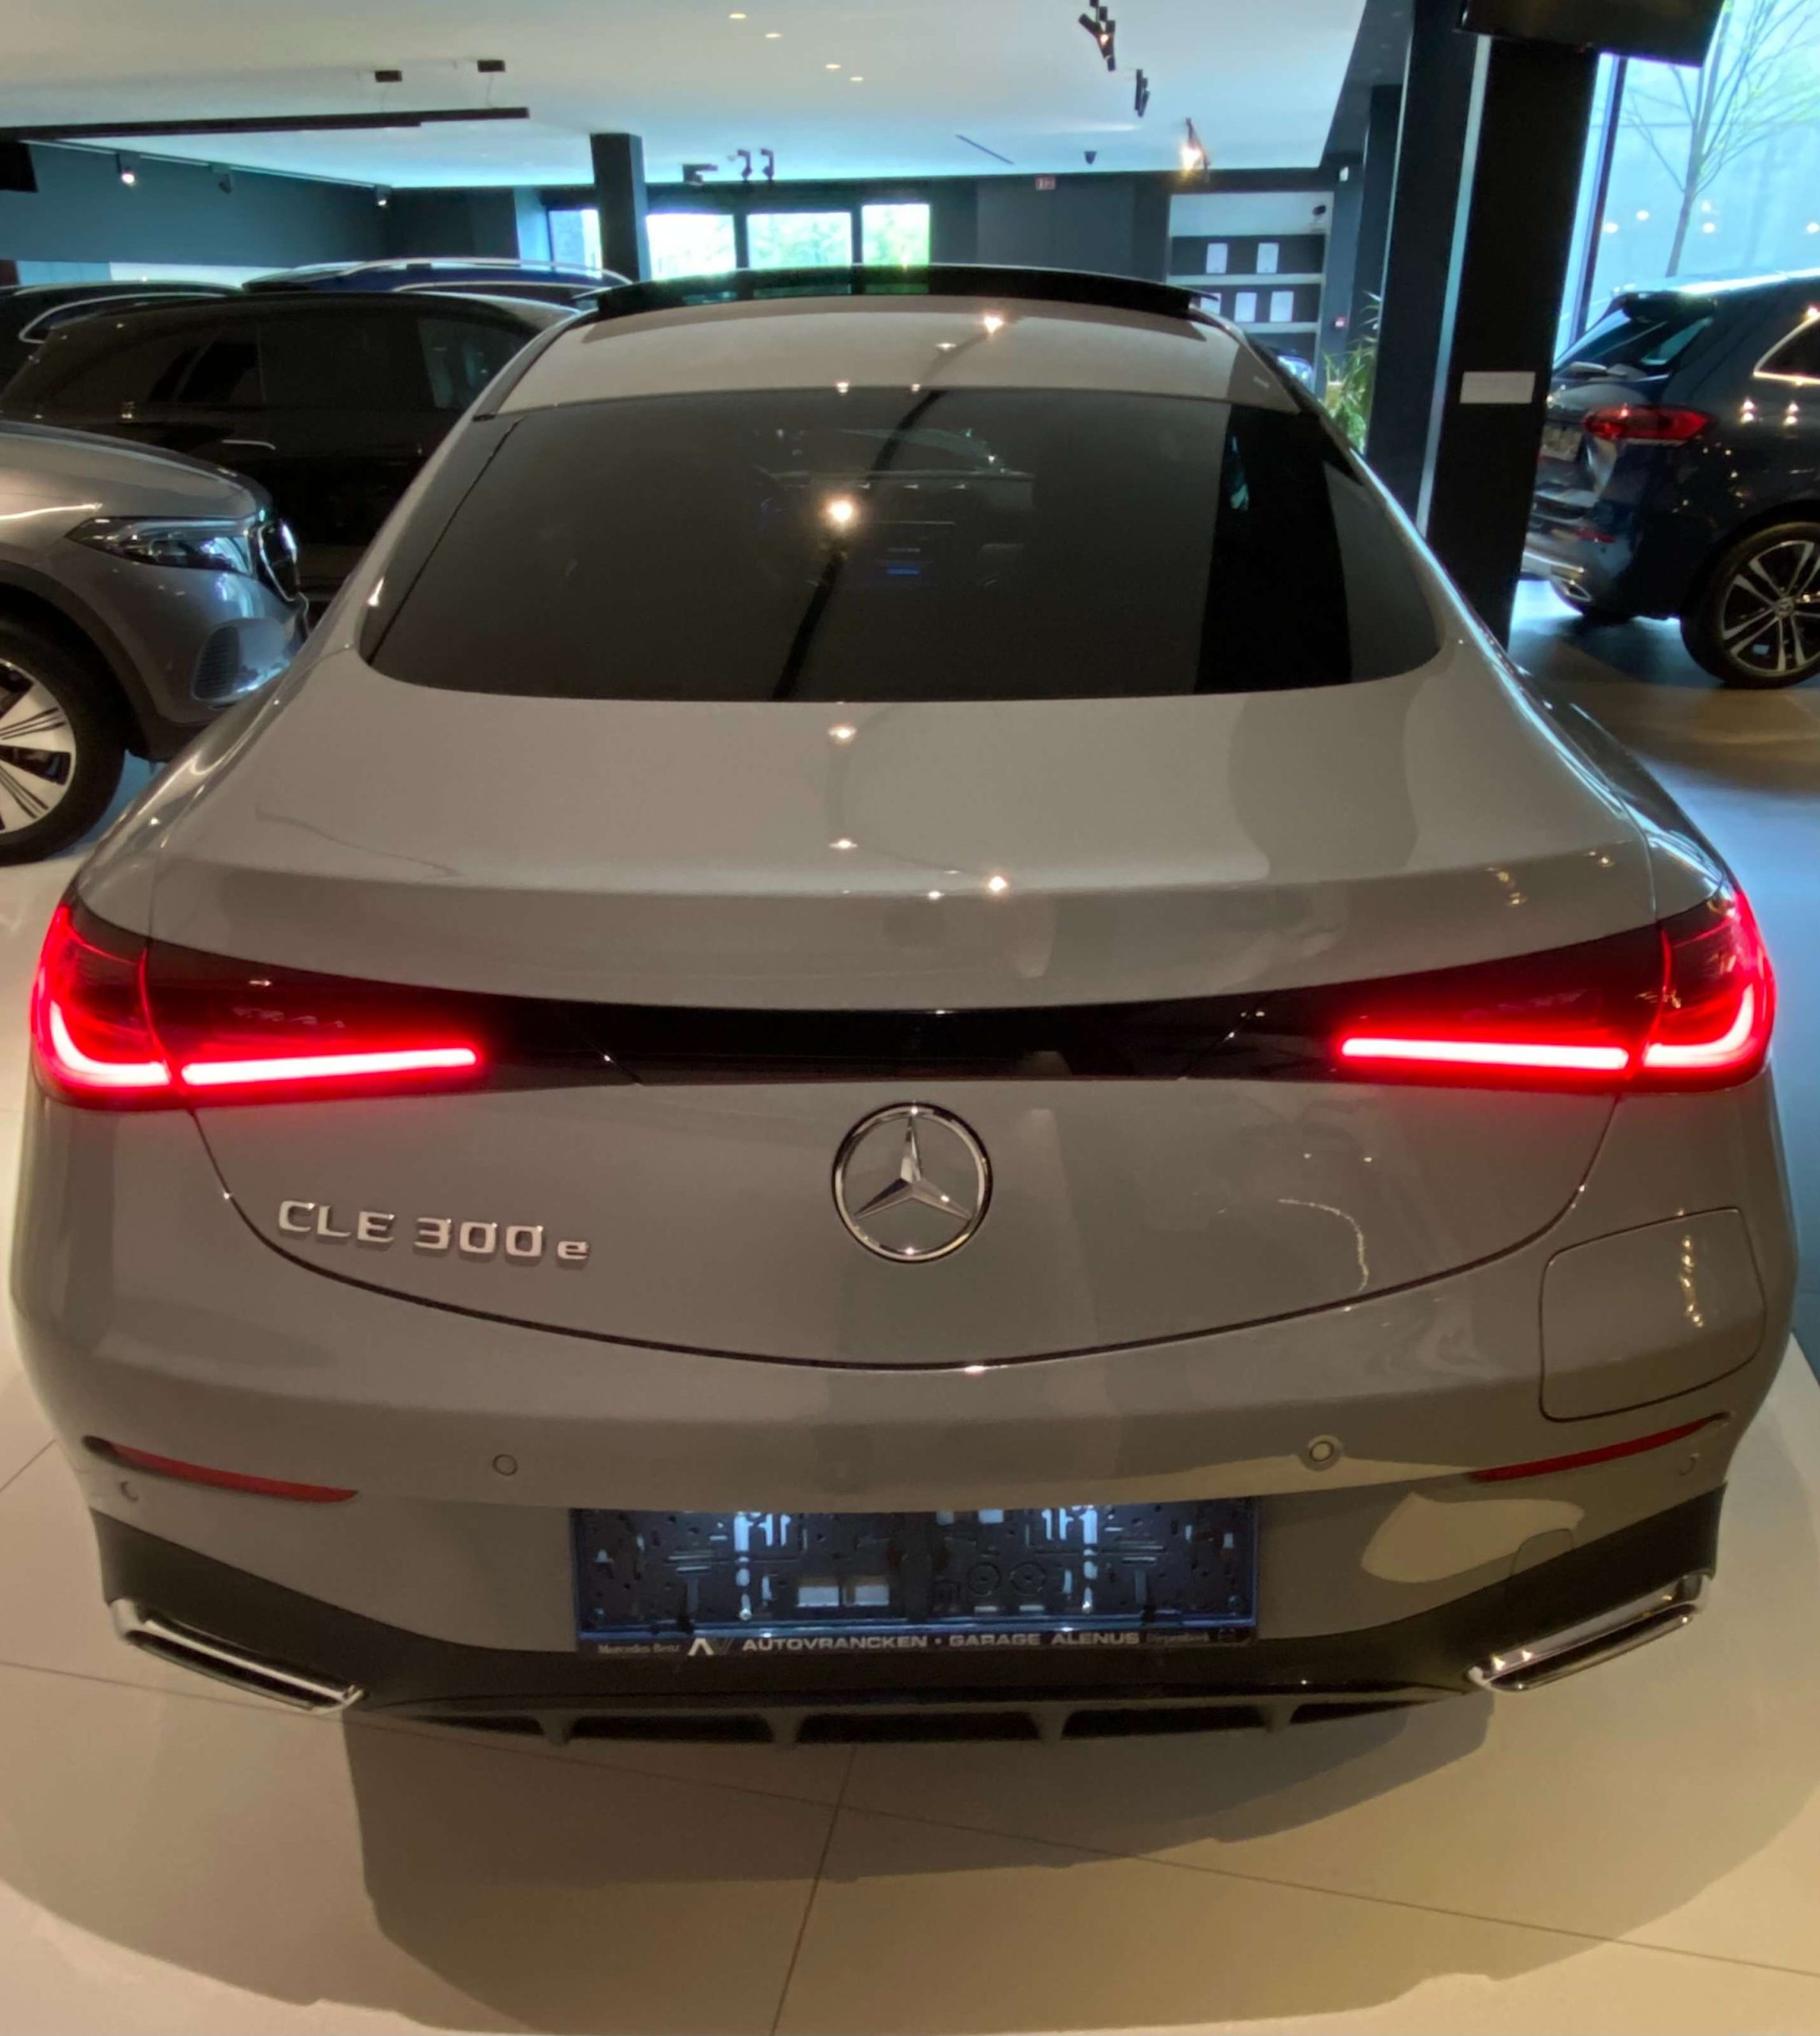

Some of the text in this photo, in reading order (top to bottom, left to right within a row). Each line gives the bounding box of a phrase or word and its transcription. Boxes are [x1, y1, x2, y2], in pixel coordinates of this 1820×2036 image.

[278, 1199, 588, 1260] CLE 300 e
[743, 1635, 928, 1651] AUTOVRANCKEN
[949, 1633, 1042, 1648] GARAGE
[1051, 1632, 1141, 1646] ALENUS
